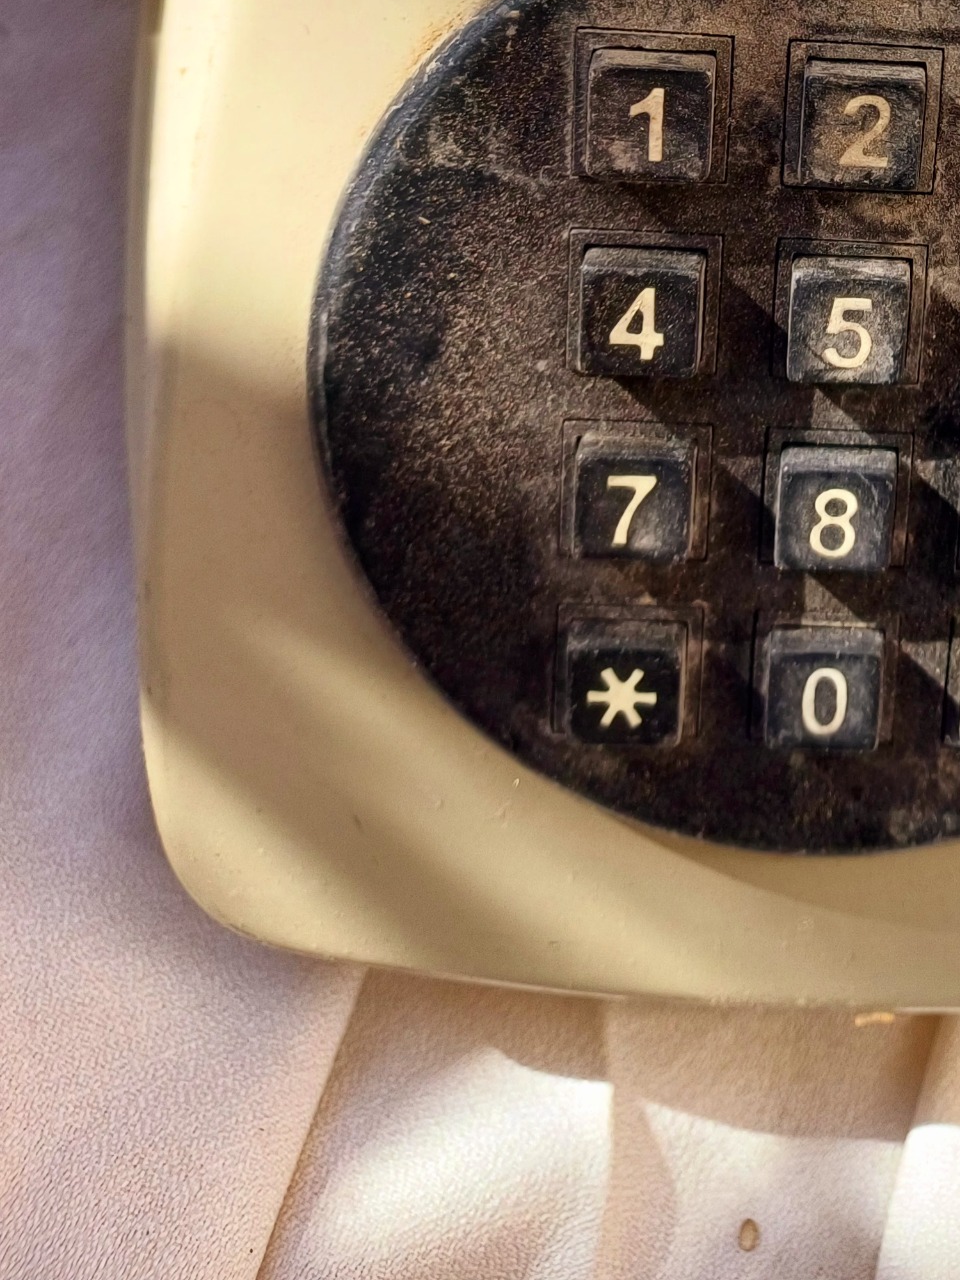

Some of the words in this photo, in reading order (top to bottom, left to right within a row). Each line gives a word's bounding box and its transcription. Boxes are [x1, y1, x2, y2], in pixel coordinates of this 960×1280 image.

[629, 88, 666, 163] 1
[841, 95, 892, 169] 2
[608, 287, 665, 360] 4
[821, 297, 873, 368] 5
[606, 475, 658, 546] 7
[809, 488, 859, 559] 8
[801, 667, 848, 736] 0
